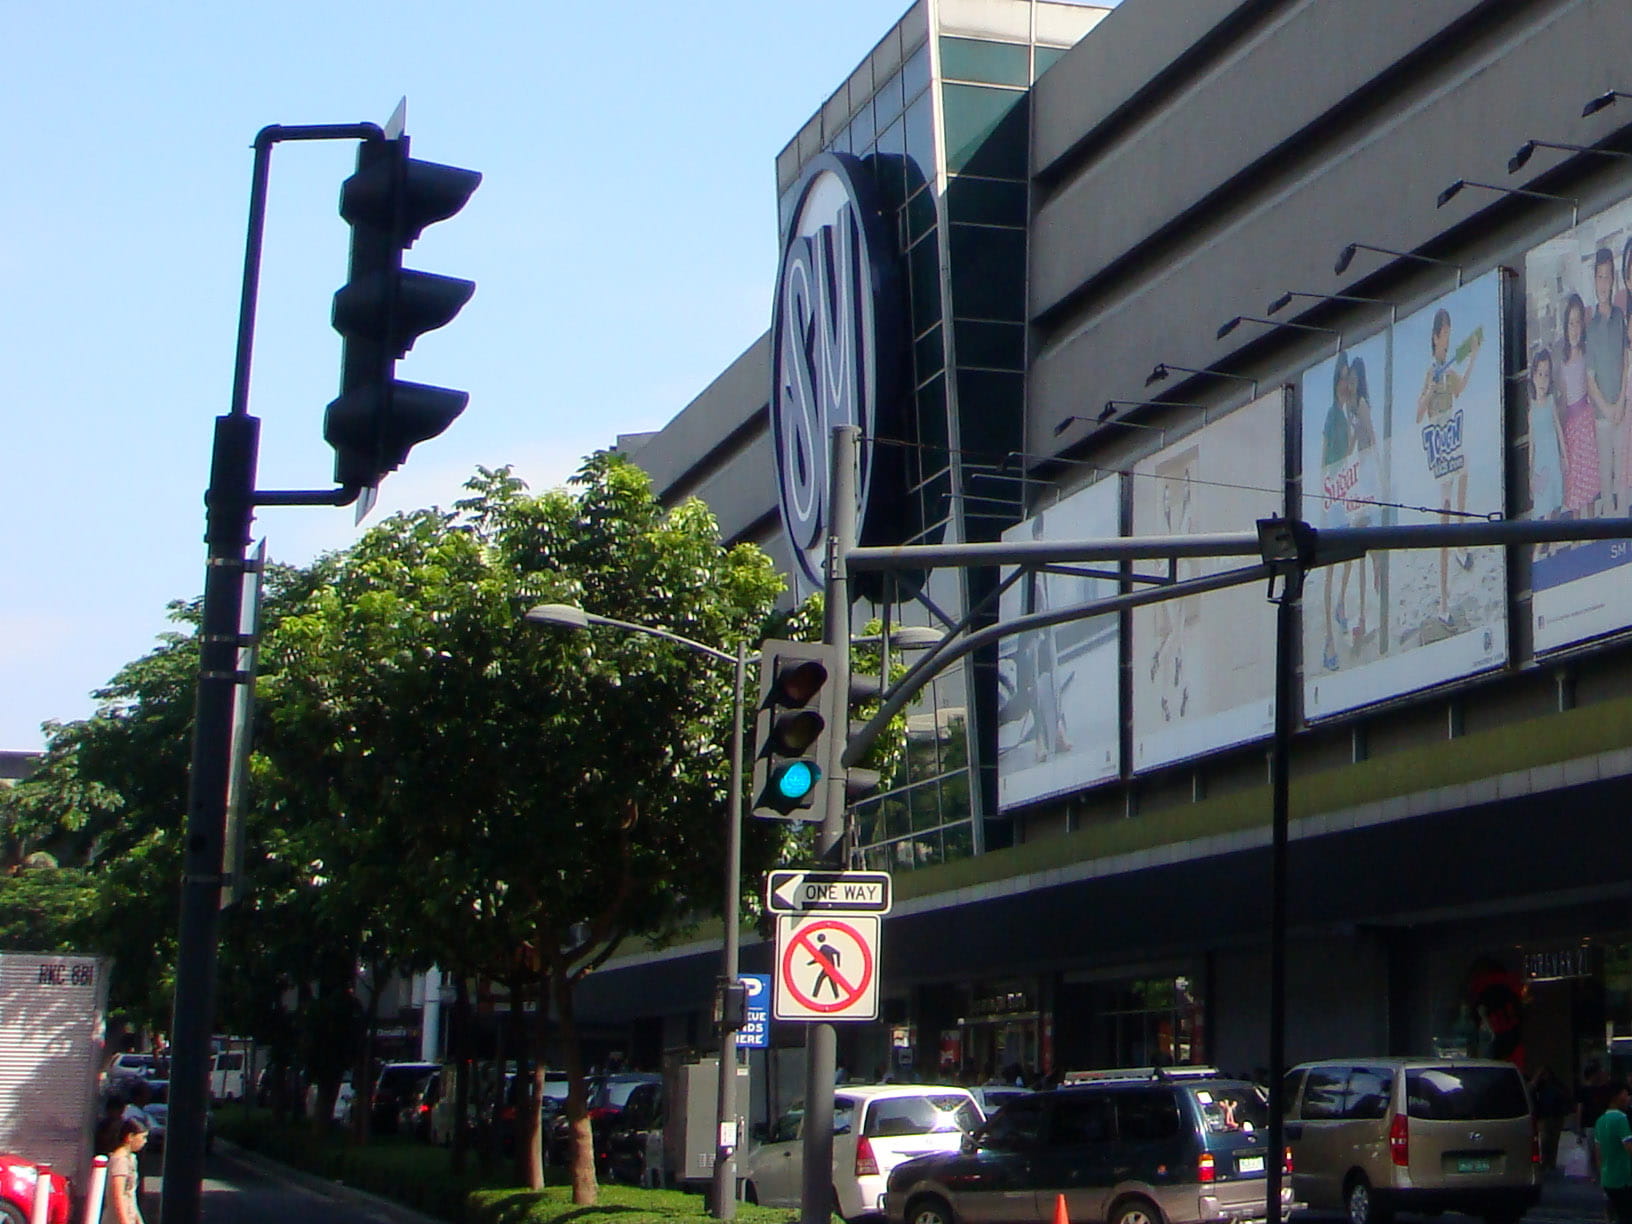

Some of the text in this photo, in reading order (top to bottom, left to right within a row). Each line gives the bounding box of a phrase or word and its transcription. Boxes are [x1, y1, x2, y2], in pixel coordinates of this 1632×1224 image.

[780, 200, 866, 550] SM
[1610, 542, 1627, 559] SM
[806, 884, 877, 900] ONE WAY
